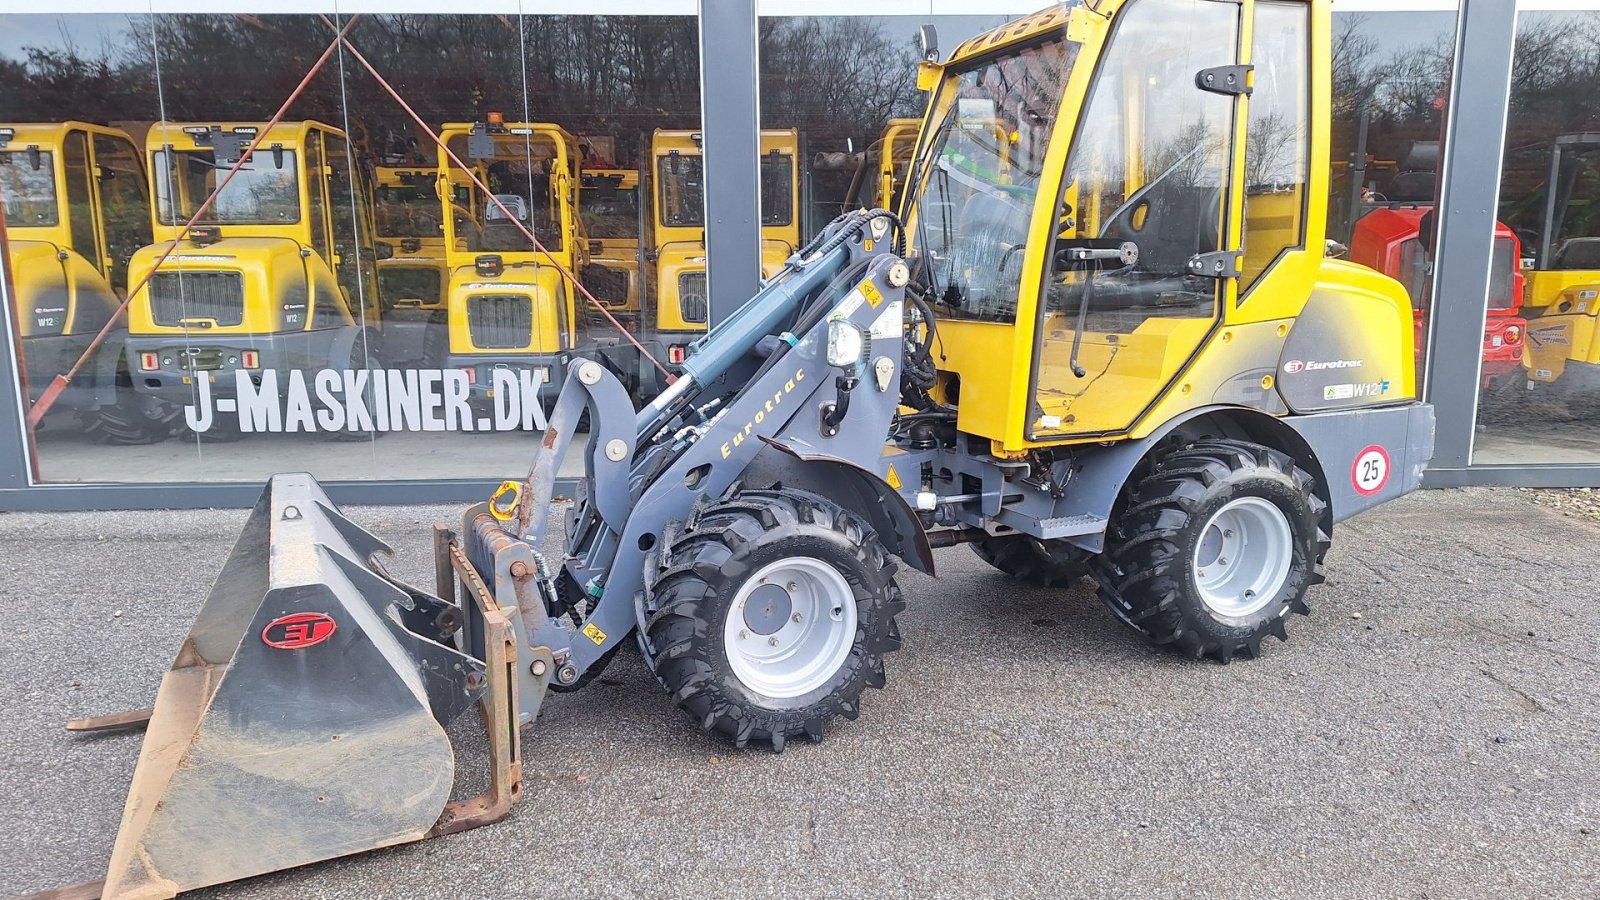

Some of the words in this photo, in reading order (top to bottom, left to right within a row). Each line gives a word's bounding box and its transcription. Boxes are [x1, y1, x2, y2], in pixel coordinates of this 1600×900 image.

[1305, 360, 1364, 371] Eurotrac
[184, 368, 548, 433] J-MASKINER.DK
[720, 368, 805, 459] Eurotrac
[1363, 459, 1379, 482] 25
[264, 614, 335, 646] ET
